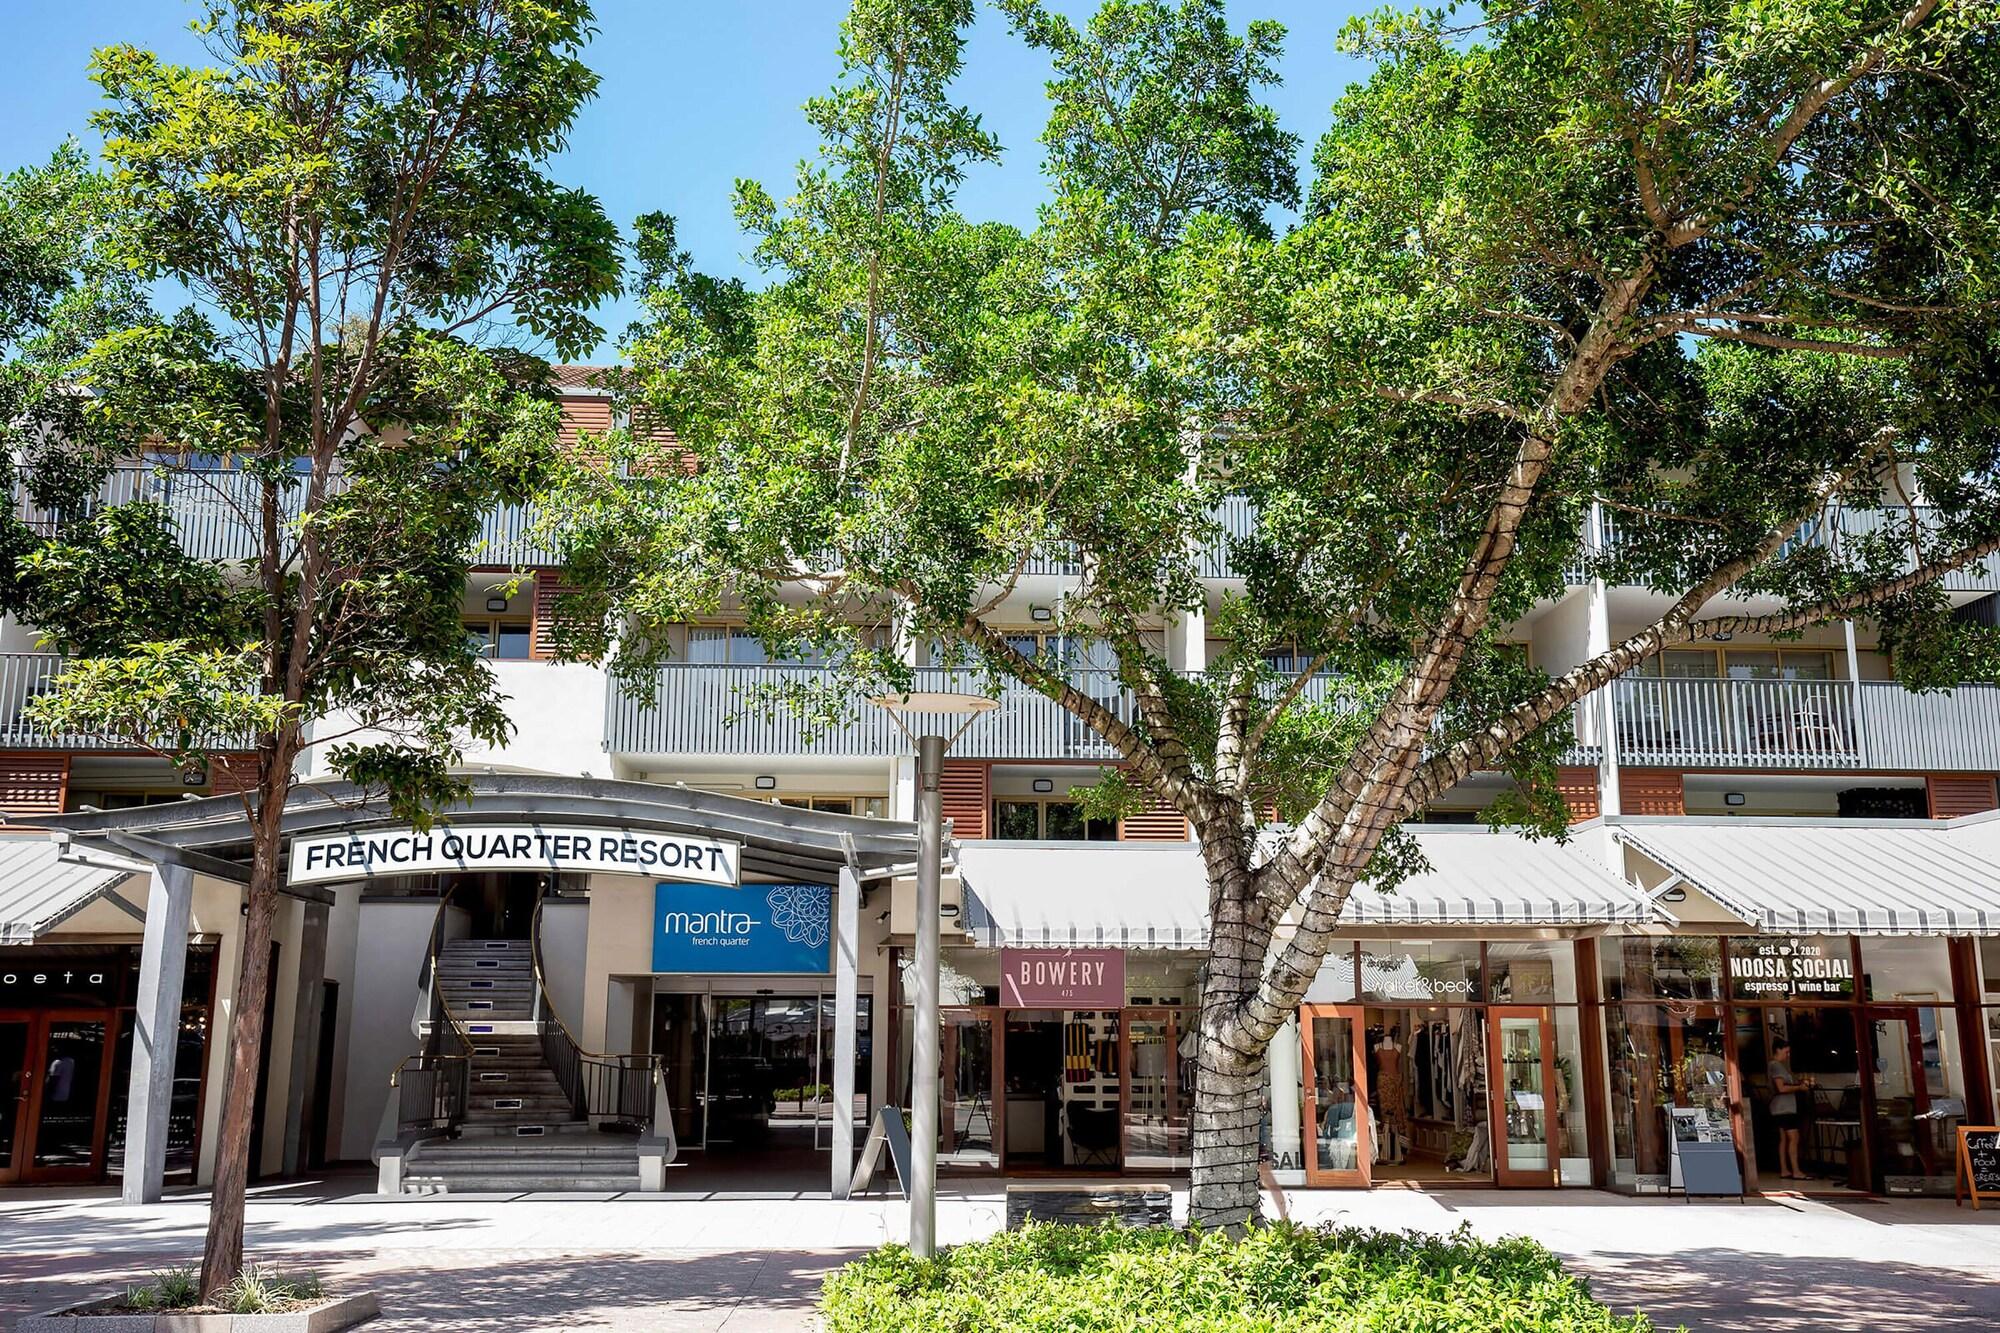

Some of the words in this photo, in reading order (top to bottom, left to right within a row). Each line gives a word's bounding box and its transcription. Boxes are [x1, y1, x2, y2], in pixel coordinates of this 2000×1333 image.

[306, 836, 433, 870] FRENCH
[441, 834, 592, 861] QUARTER
[599, 837, 723, 872] RESORT
[665, 909, 761, 934] mantra
[692, 936, 718, 946] french
[720, 937, 750, 947] quarter
[1759, 944, 1779, 956] est.
[1800, 946, 1821, 956] 2020
[1021, 961, 1105, 986] BOWERY
[1730, 957, 1788, 978] NOOSA
[1792, 958, 1854, 979] SOCIAL
[1744, 980, 1789, 994] espresso
[1799, 980, 1822, 992] wine
[1823, 980, 1841, 993] bar
